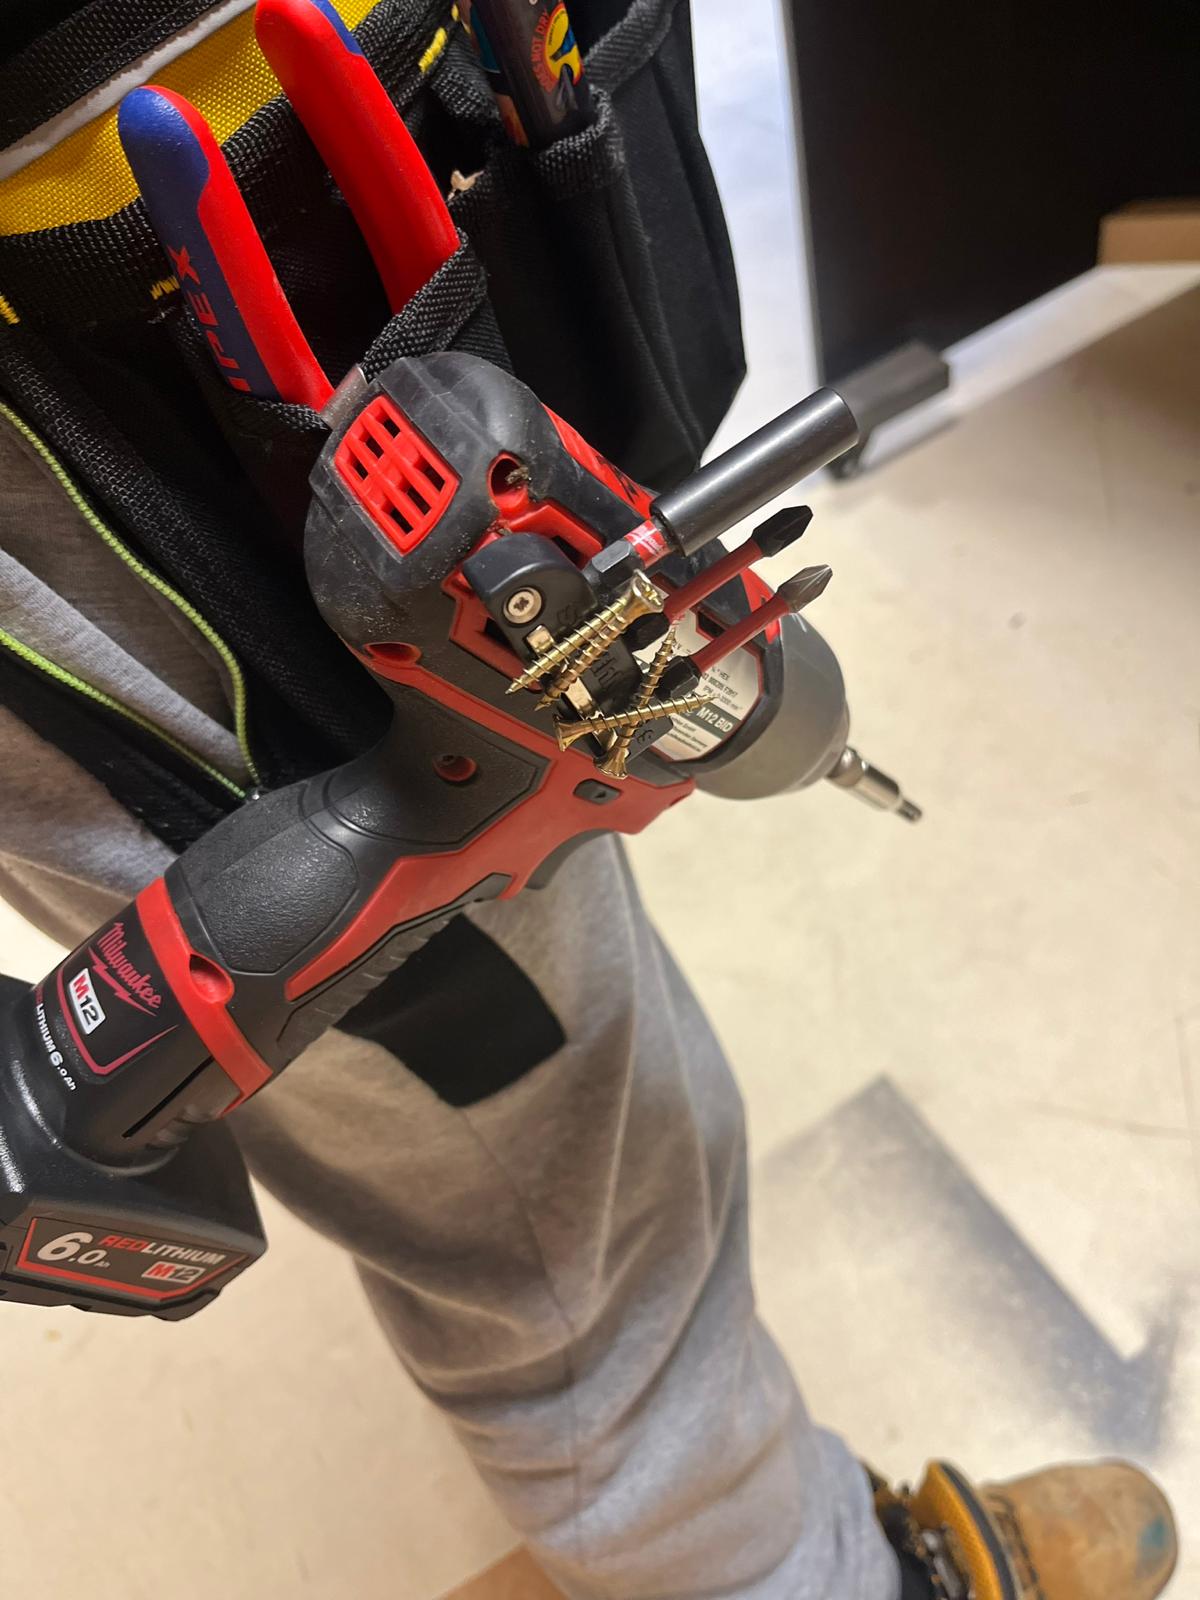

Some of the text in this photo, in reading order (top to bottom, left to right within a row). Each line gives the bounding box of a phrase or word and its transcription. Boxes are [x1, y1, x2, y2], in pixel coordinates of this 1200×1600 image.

[696, 706, 719, 725] M12
[97, 922, 162, 1009] Milwaukee
[73, 973, 100, 1026] M12
[99, 1234, 227, 1265] REDLITHIUM
[147, 1262, 199, 1283] M12
